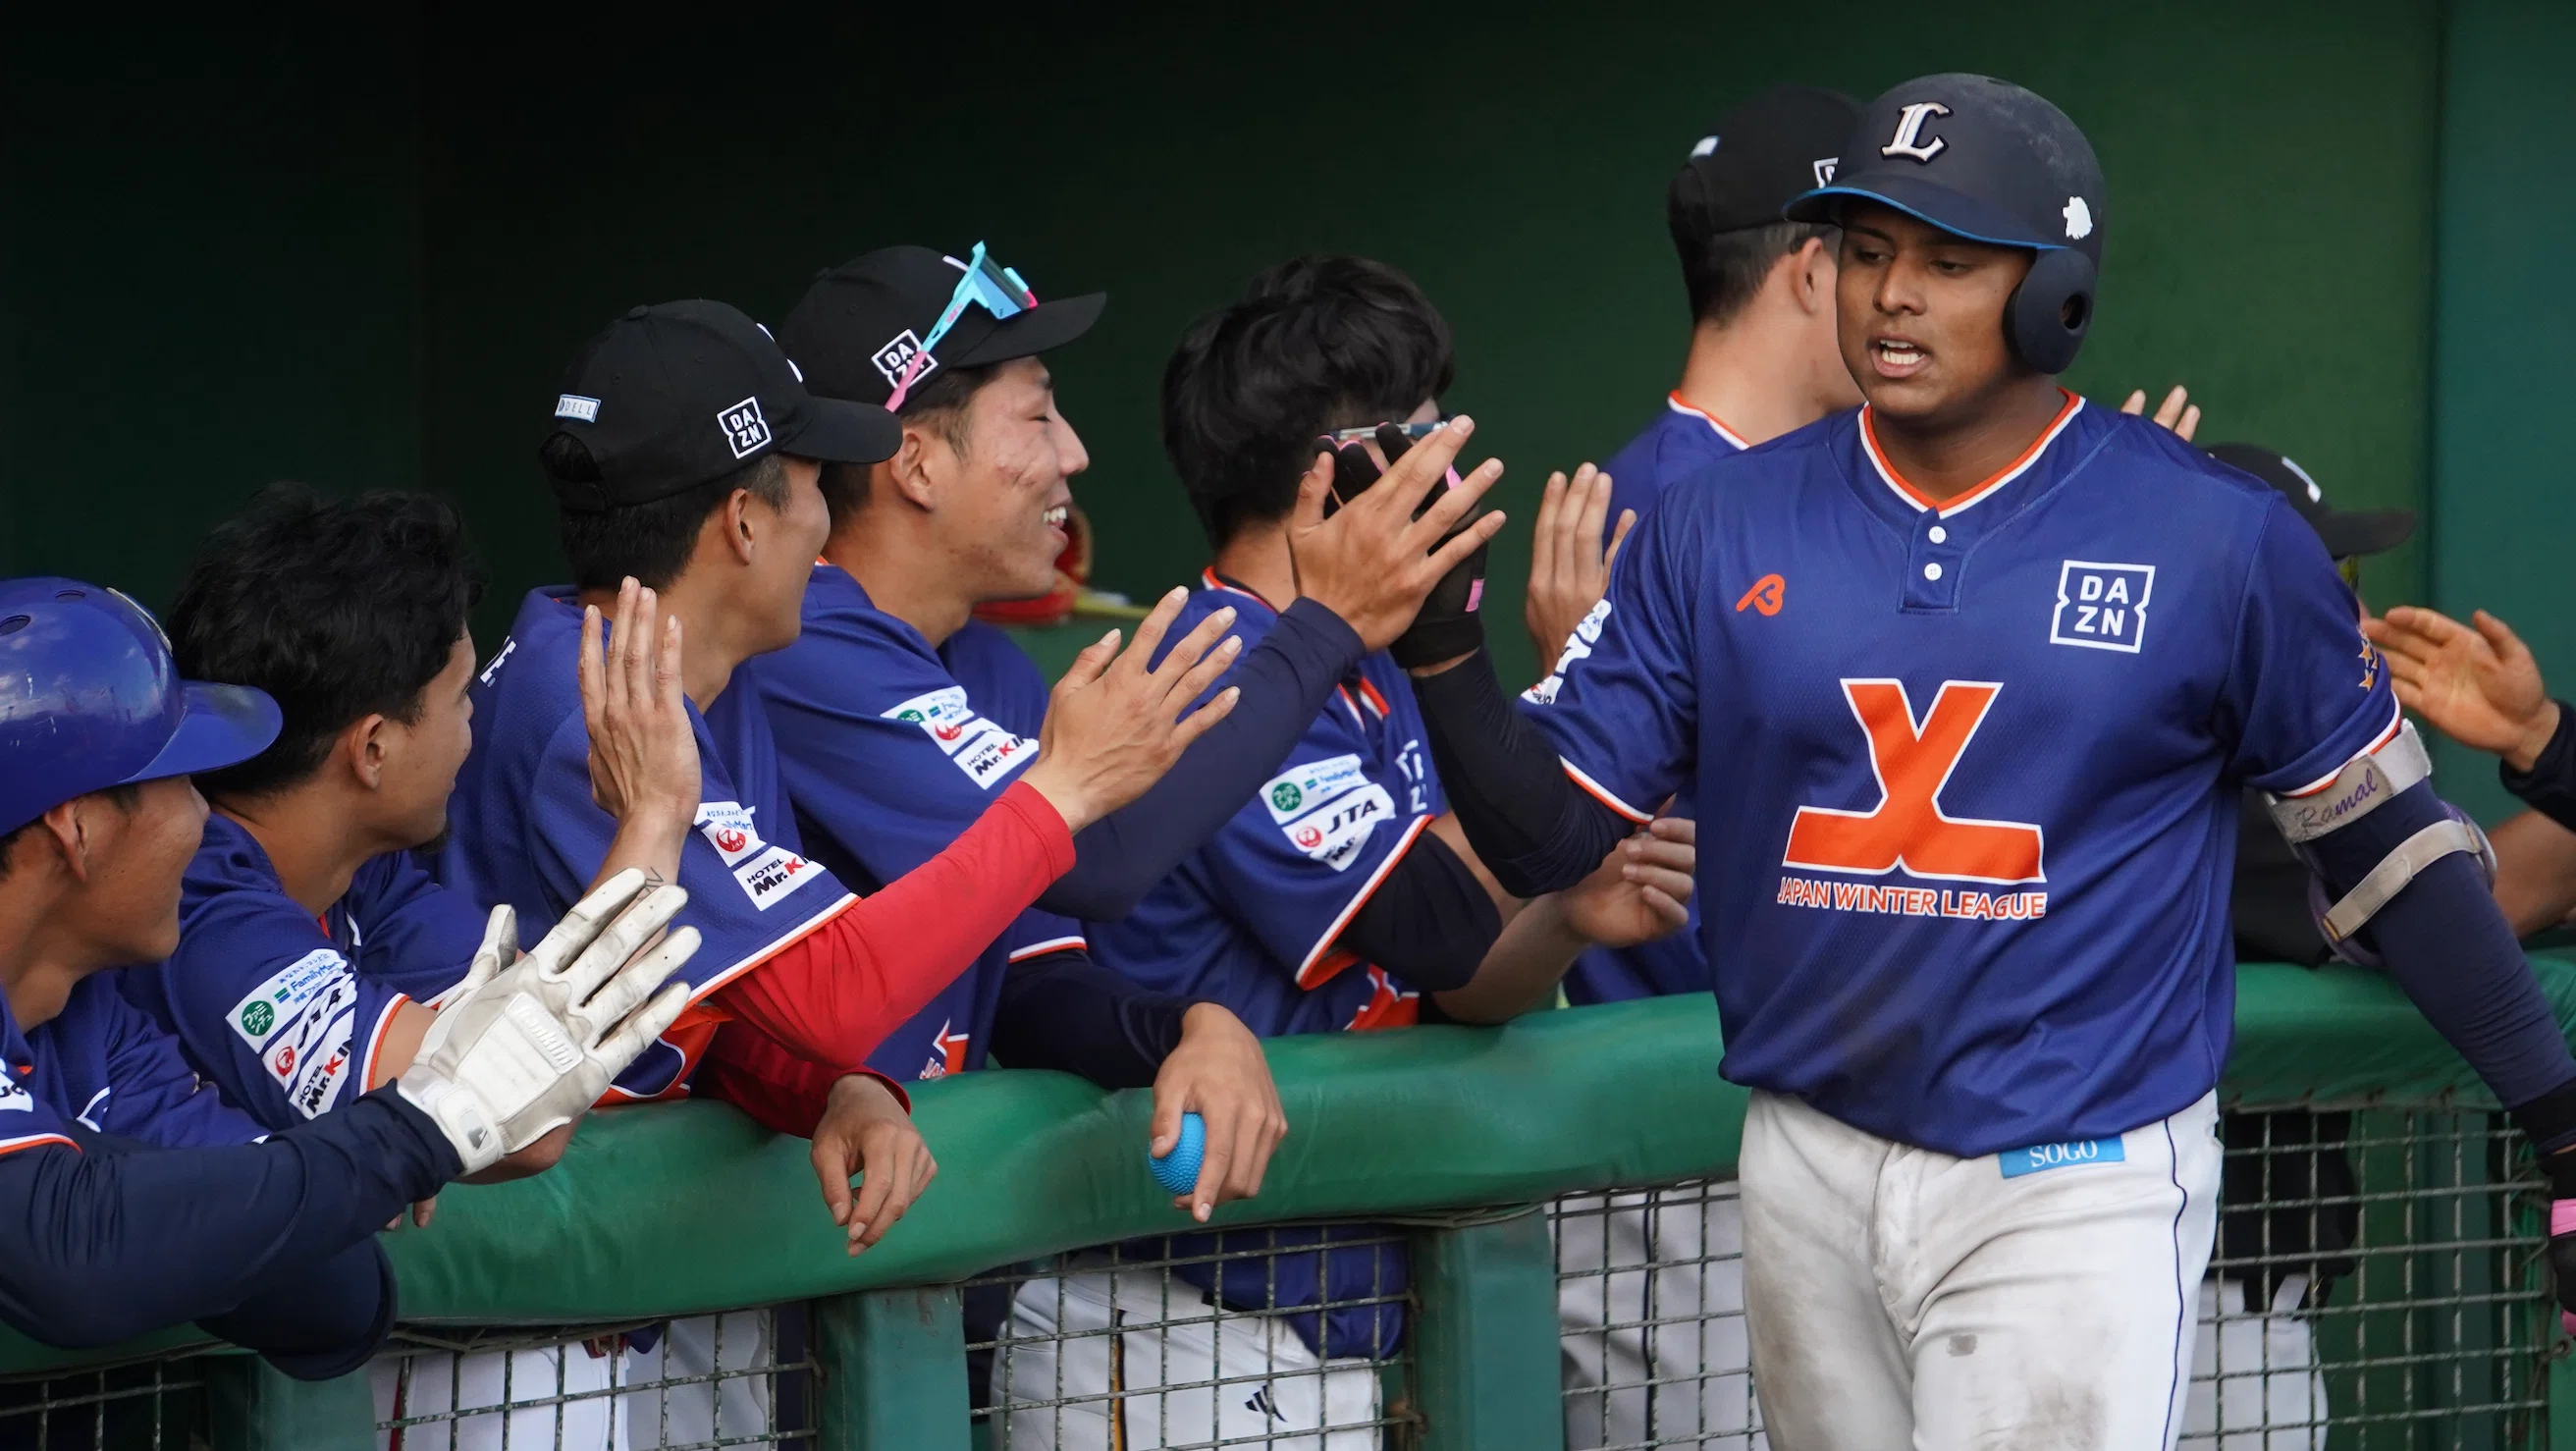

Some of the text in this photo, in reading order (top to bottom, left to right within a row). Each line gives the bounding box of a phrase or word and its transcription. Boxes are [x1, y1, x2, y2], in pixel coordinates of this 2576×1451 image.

[1881, 102, 1950, 161] L
[967, 742, 996, 767] HOTEL
[1328, 799, 1379, 834] JTA
[747, 858, 784, 884] HOTEL
[753, 857, 809, 896] Mr.K
[1777, 877, 2048, 921] JAPAN WINTER LEAGUE
[298, 1064, 324, 1105] HOTEL
[2028, 1139, 2098, 1168] SOGO
